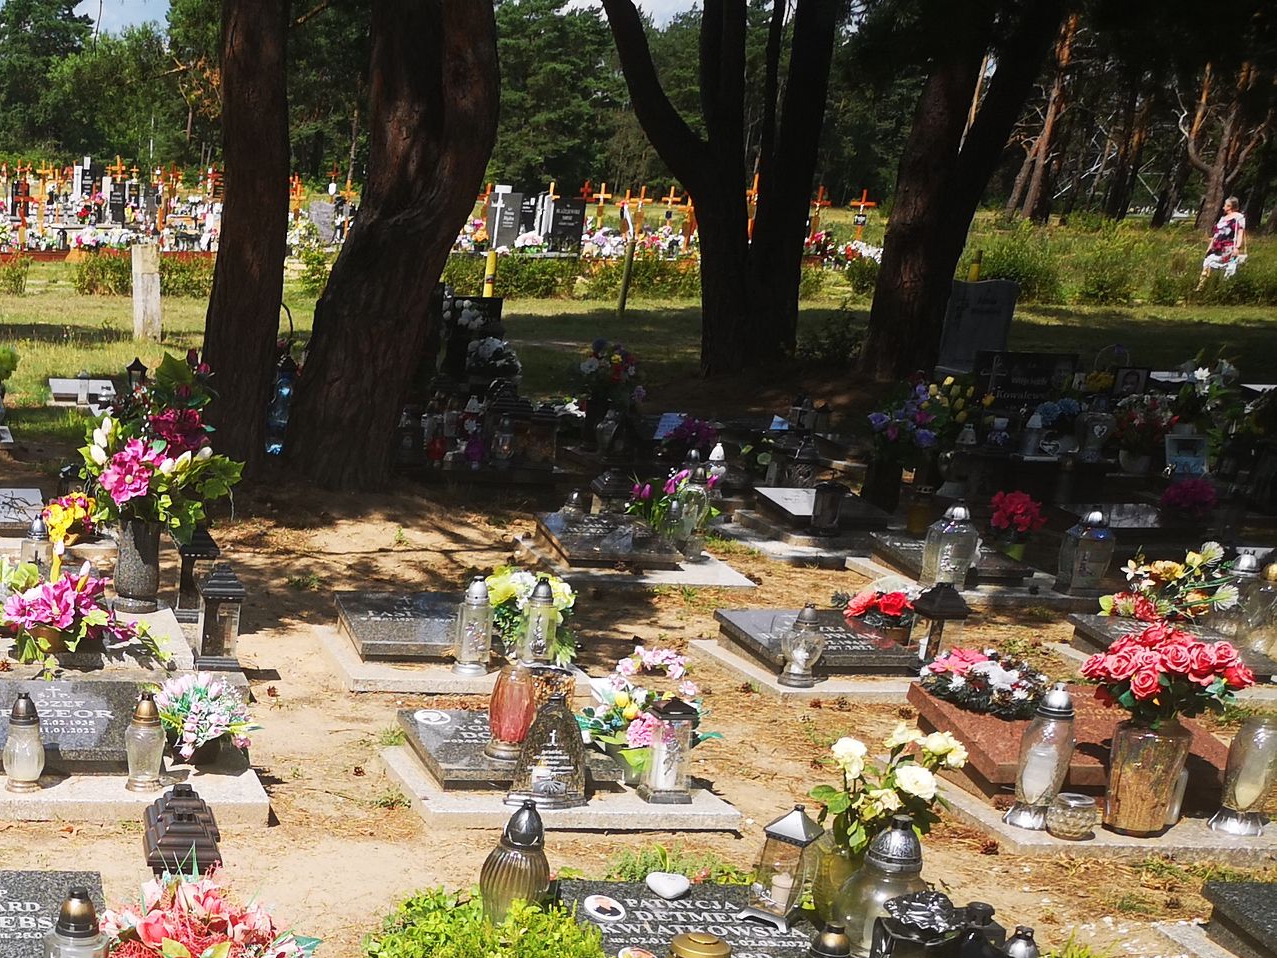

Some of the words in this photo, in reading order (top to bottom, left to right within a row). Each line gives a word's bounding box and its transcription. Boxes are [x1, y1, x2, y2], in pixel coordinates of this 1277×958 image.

[35, 699, 86, 708] ÓZEF
[0, 709, 115, 719] PZEOR
[623, 898, 740, 910] PATRYCJA
